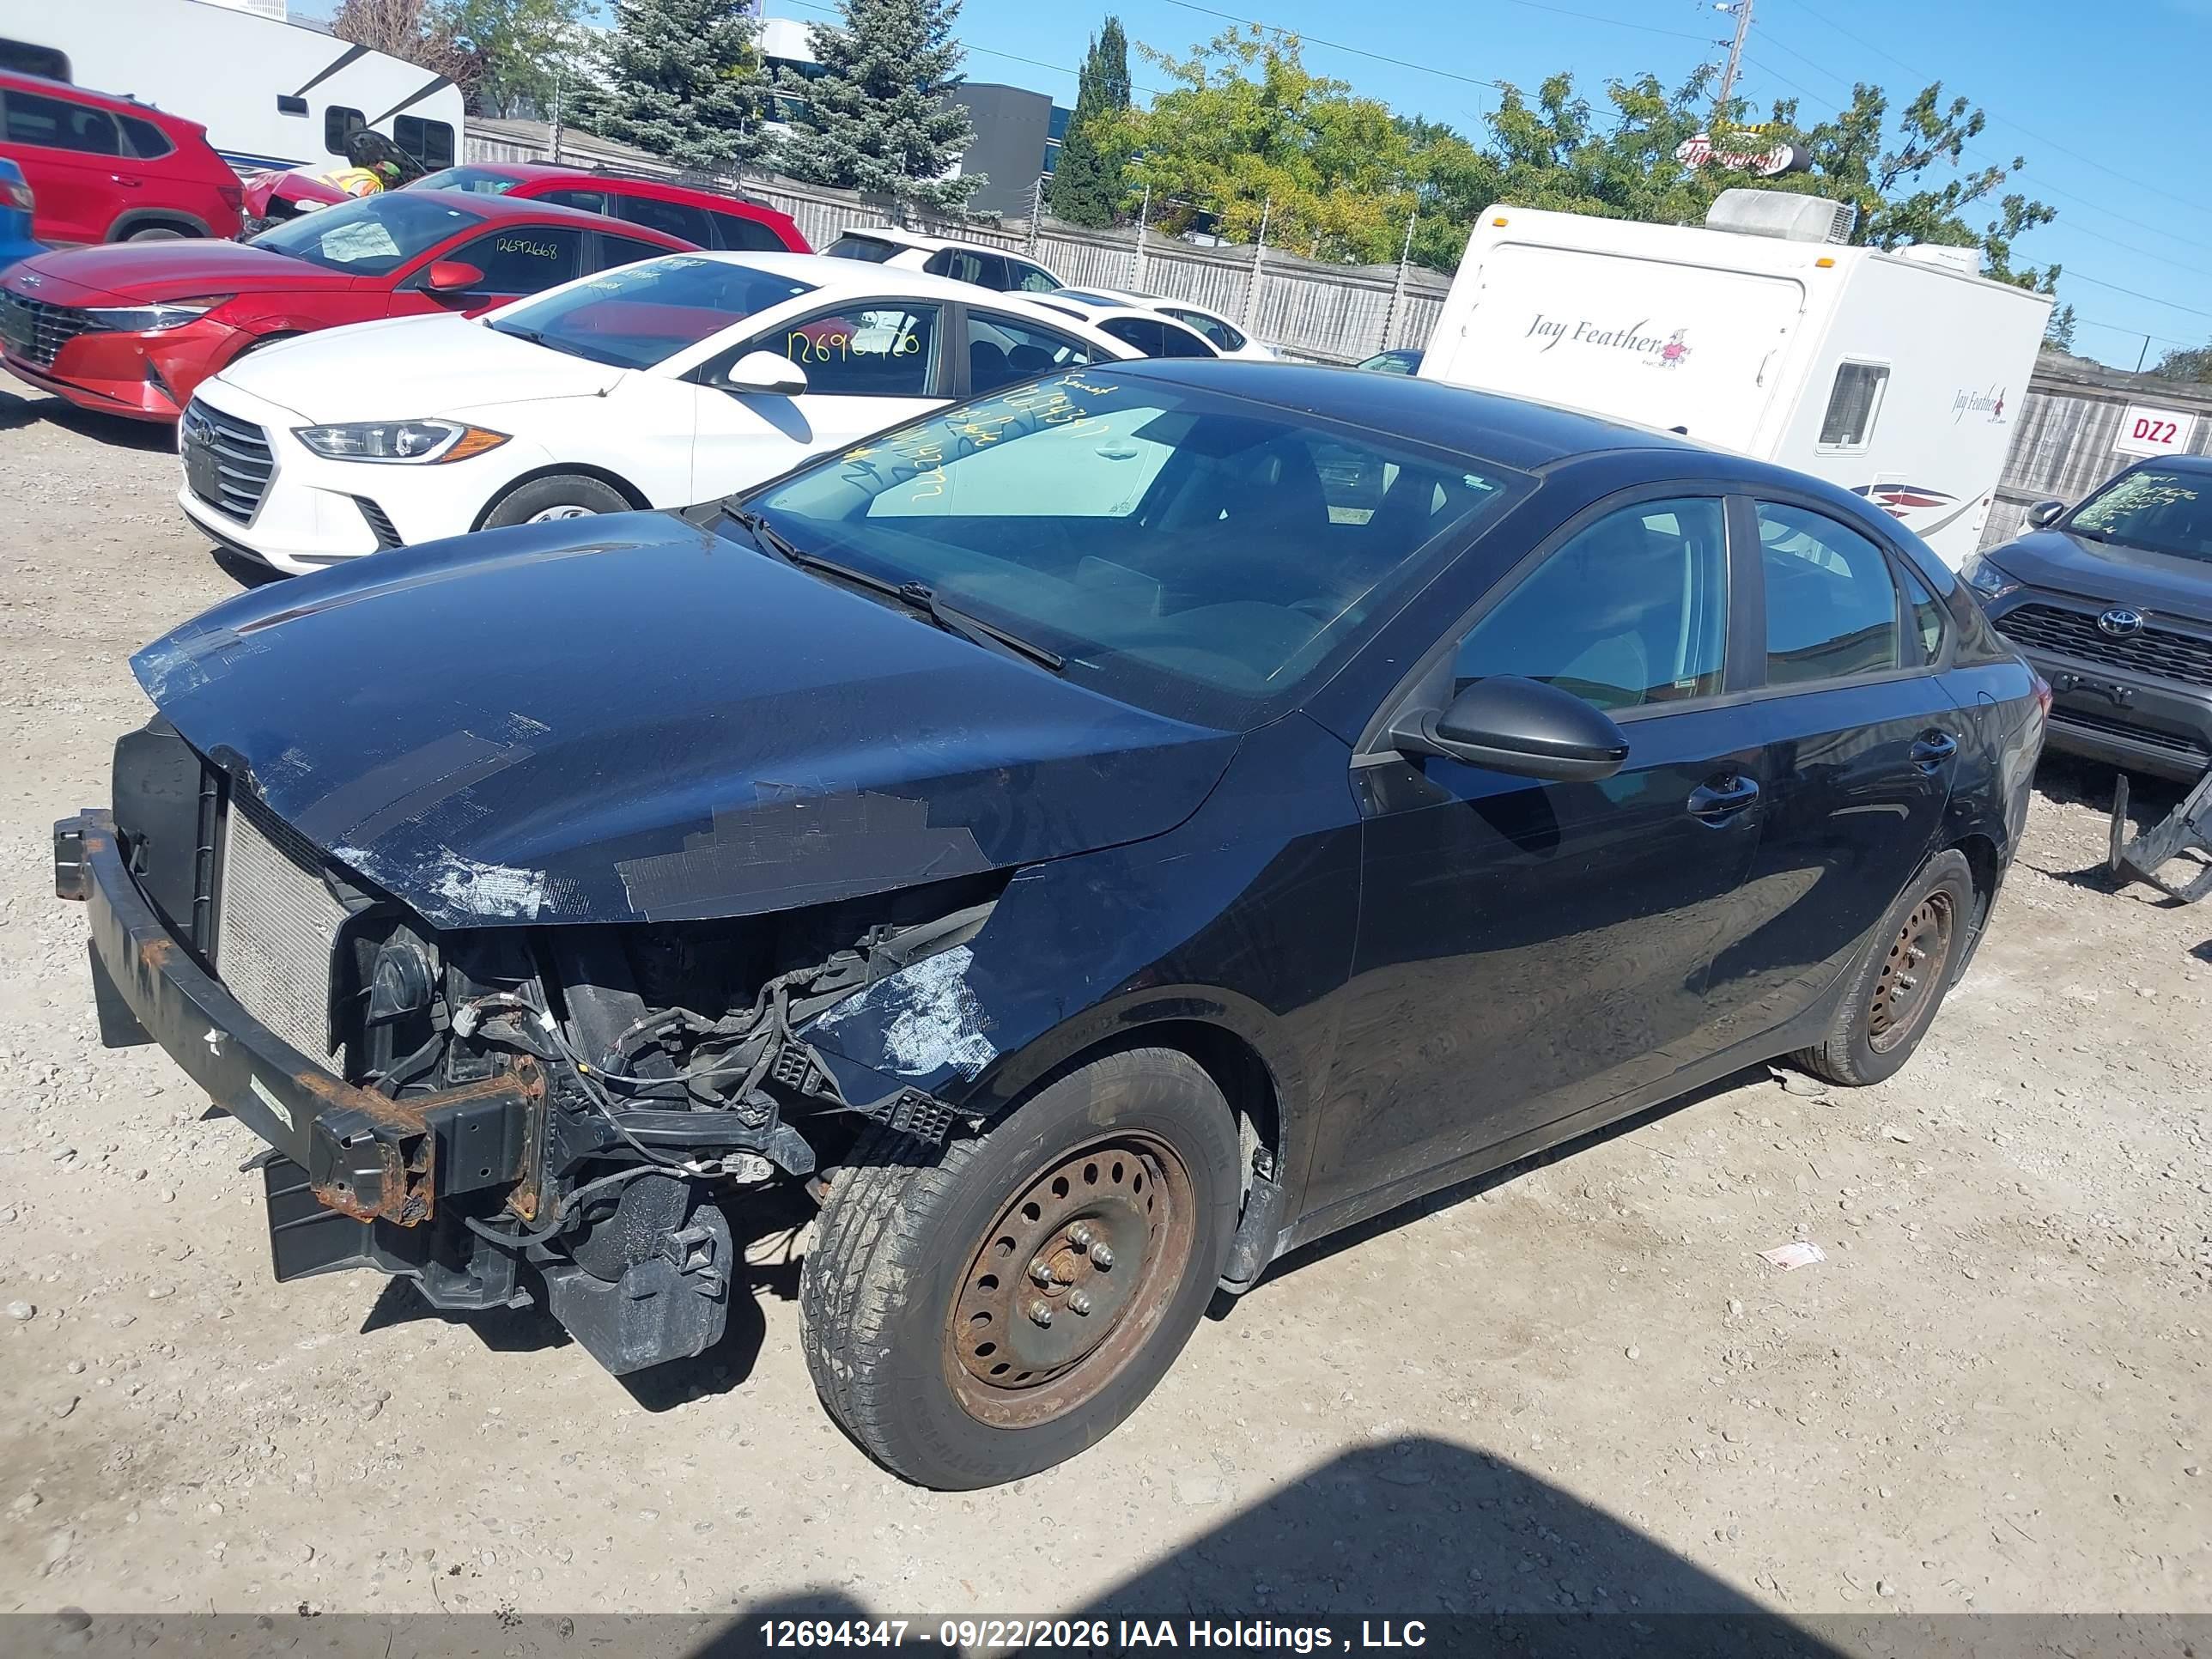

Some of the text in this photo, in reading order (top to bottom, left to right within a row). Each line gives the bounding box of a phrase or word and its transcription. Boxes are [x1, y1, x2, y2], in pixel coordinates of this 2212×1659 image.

[496, 238, 557, 260] 12692668
[1524, 313, 1662, 353] Jay Feather
[1951, 382, 1996, 425] Jay Feather
[2133, 418, 2177, 444] DZ2
